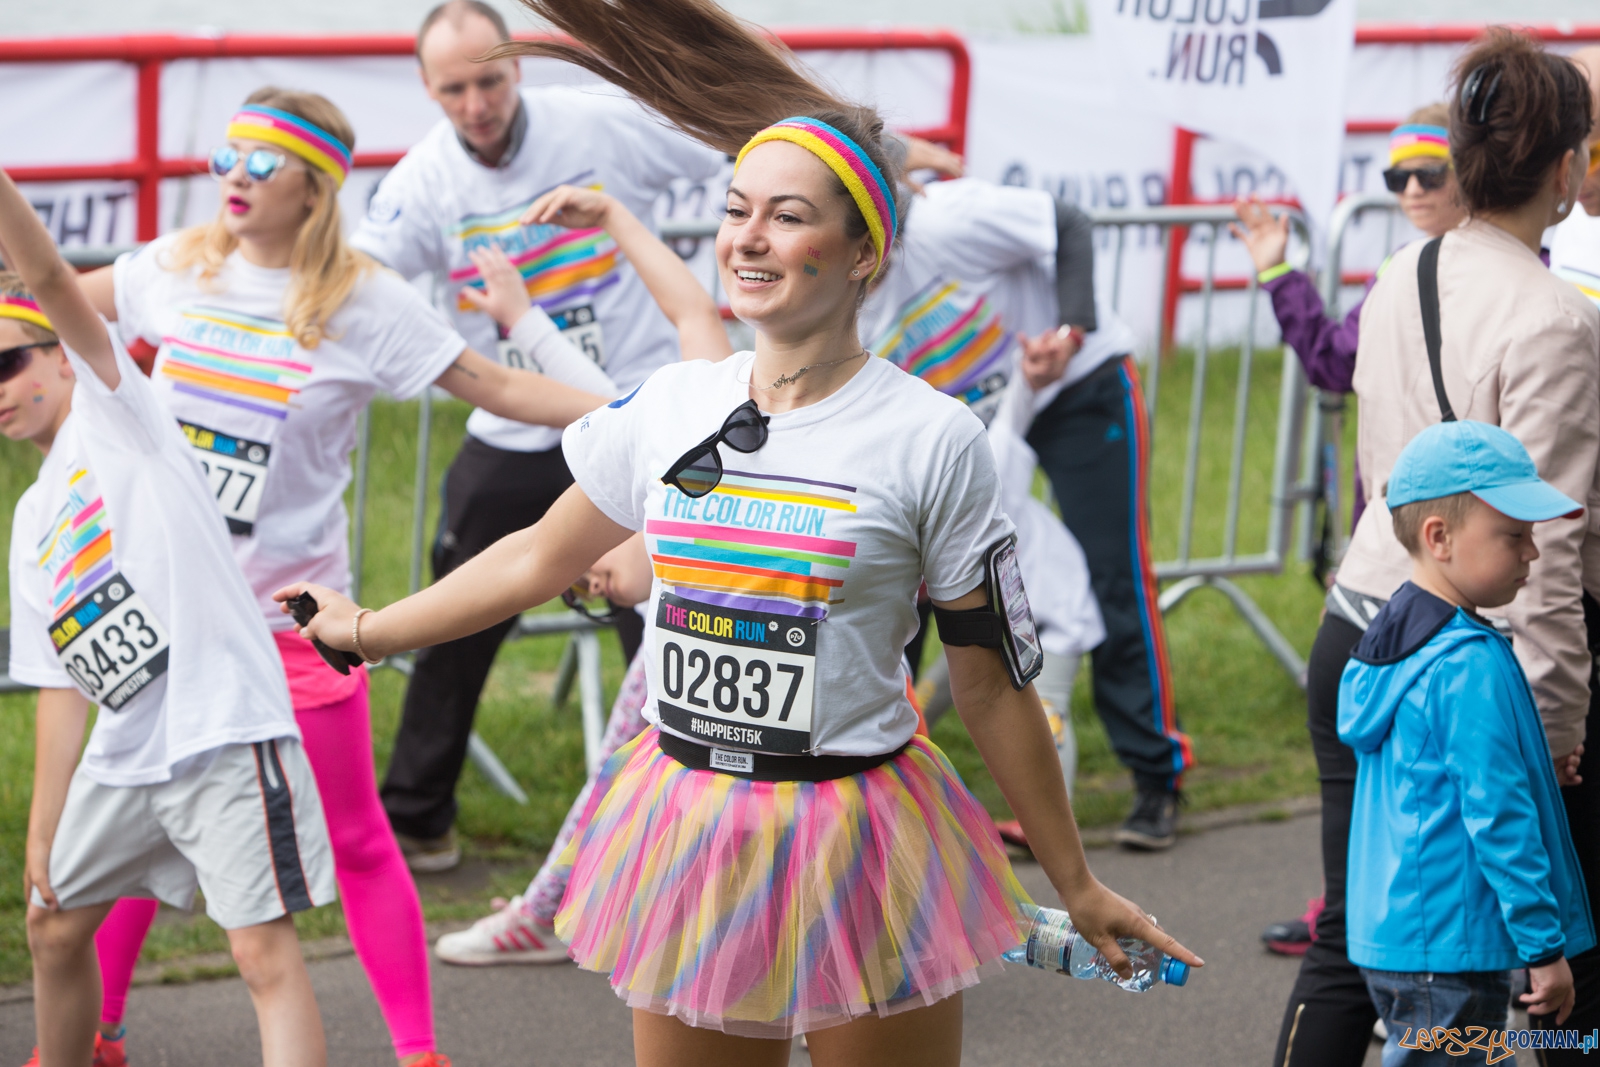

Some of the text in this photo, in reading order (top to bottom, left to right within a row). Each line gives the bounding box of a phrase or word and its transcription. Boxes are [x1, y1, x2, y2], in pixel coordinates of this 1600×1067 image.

[807, 246, 822, 260] THE
[803, 263, 819, 278] RUN
[663, 488, 700, 520] THE
[702, 494, 777, 530] COLOR
[666, 603, 687, 629] THE
[688, 610, 733, 639] COLOR
[65, 609, 159, 697] 03433
[663, 641, 805, 723] 02837
[690, 717, 763, 746] #HAPPIEST5K
[715, 752, 723, 762] THE
[723, 754, 737, 764] COLOR
